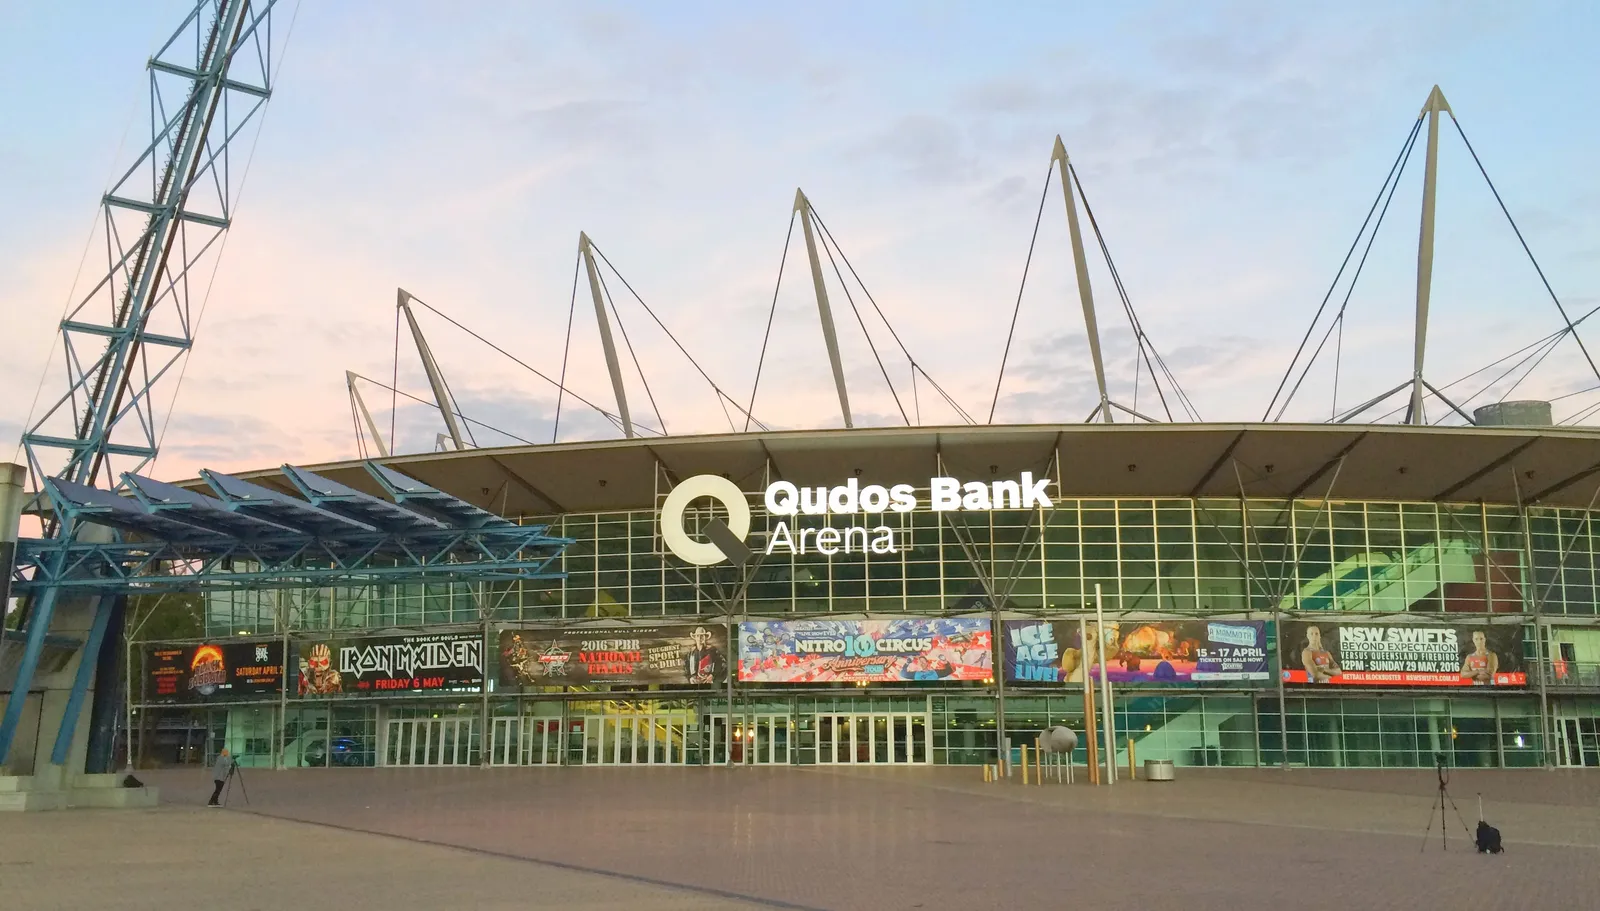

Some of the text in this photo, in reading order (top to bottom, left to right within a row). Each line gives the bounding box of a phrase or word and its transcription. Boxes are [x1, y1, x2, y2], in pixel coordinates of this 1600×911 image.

[764, 472, 1054, 516] Qudos Bank
[766, 521, 898, 555] Arena
[1010, 623, 1054, 647] ICE
[1216, 629, 1252, 640] MAMMOTH
[1339, 627, 1458, 643] NSW SWIFTS
[581, 639, 640, 651] 2016 PBR
[648, 644, 681, 654] TOUGHEST
[795, 634, 933, 657] NITRO 10 CIRCUS
[1341, 642, 1456, 651] BEYOND EXPECTATION
[578, 651, 643, 663] NATIONAL
[648, 651, 681, 662] SPORT
[1016, 643, 1058, 662] AGE
[1196, 648, 1208, 657] 15
[1218, 648, 1230, 657] 17
[1232, 648, 1266, 657] APRIL
[1341, 651, 1459, 661] VERSUS QUEENSLAND FIREBIRDS
[340, 640, 482, 679] IRON MAIDEN
[660, 658, 682, 669] DIRT
[824, 655, 897, 671] Anniversary
[236, 667, 261, 676] SATURDAY
[263, 666, 279, 675] APRIL
[587, 663, 634, 675] FINALS
[1341, 660, 1364, 671] 12PM
[1370, 661, 1405, 671] SUNDAY
[1406, 661, 1417, 671] 29
[1418, 661, 1439, 673] MAY,
[1440, 662, 1460, 672] 2016
[1015, 664, 1058, 682] LIVE!
[1342, 672, 1365, 680] NETBALL
[1406, 674, 1459, 682] NSWSWIFTS.COM.AU
[375, 679, 410, 689] FRIDAY
[413, 678, 420, 688] 6
[423, 677, 445, 687] MAY
